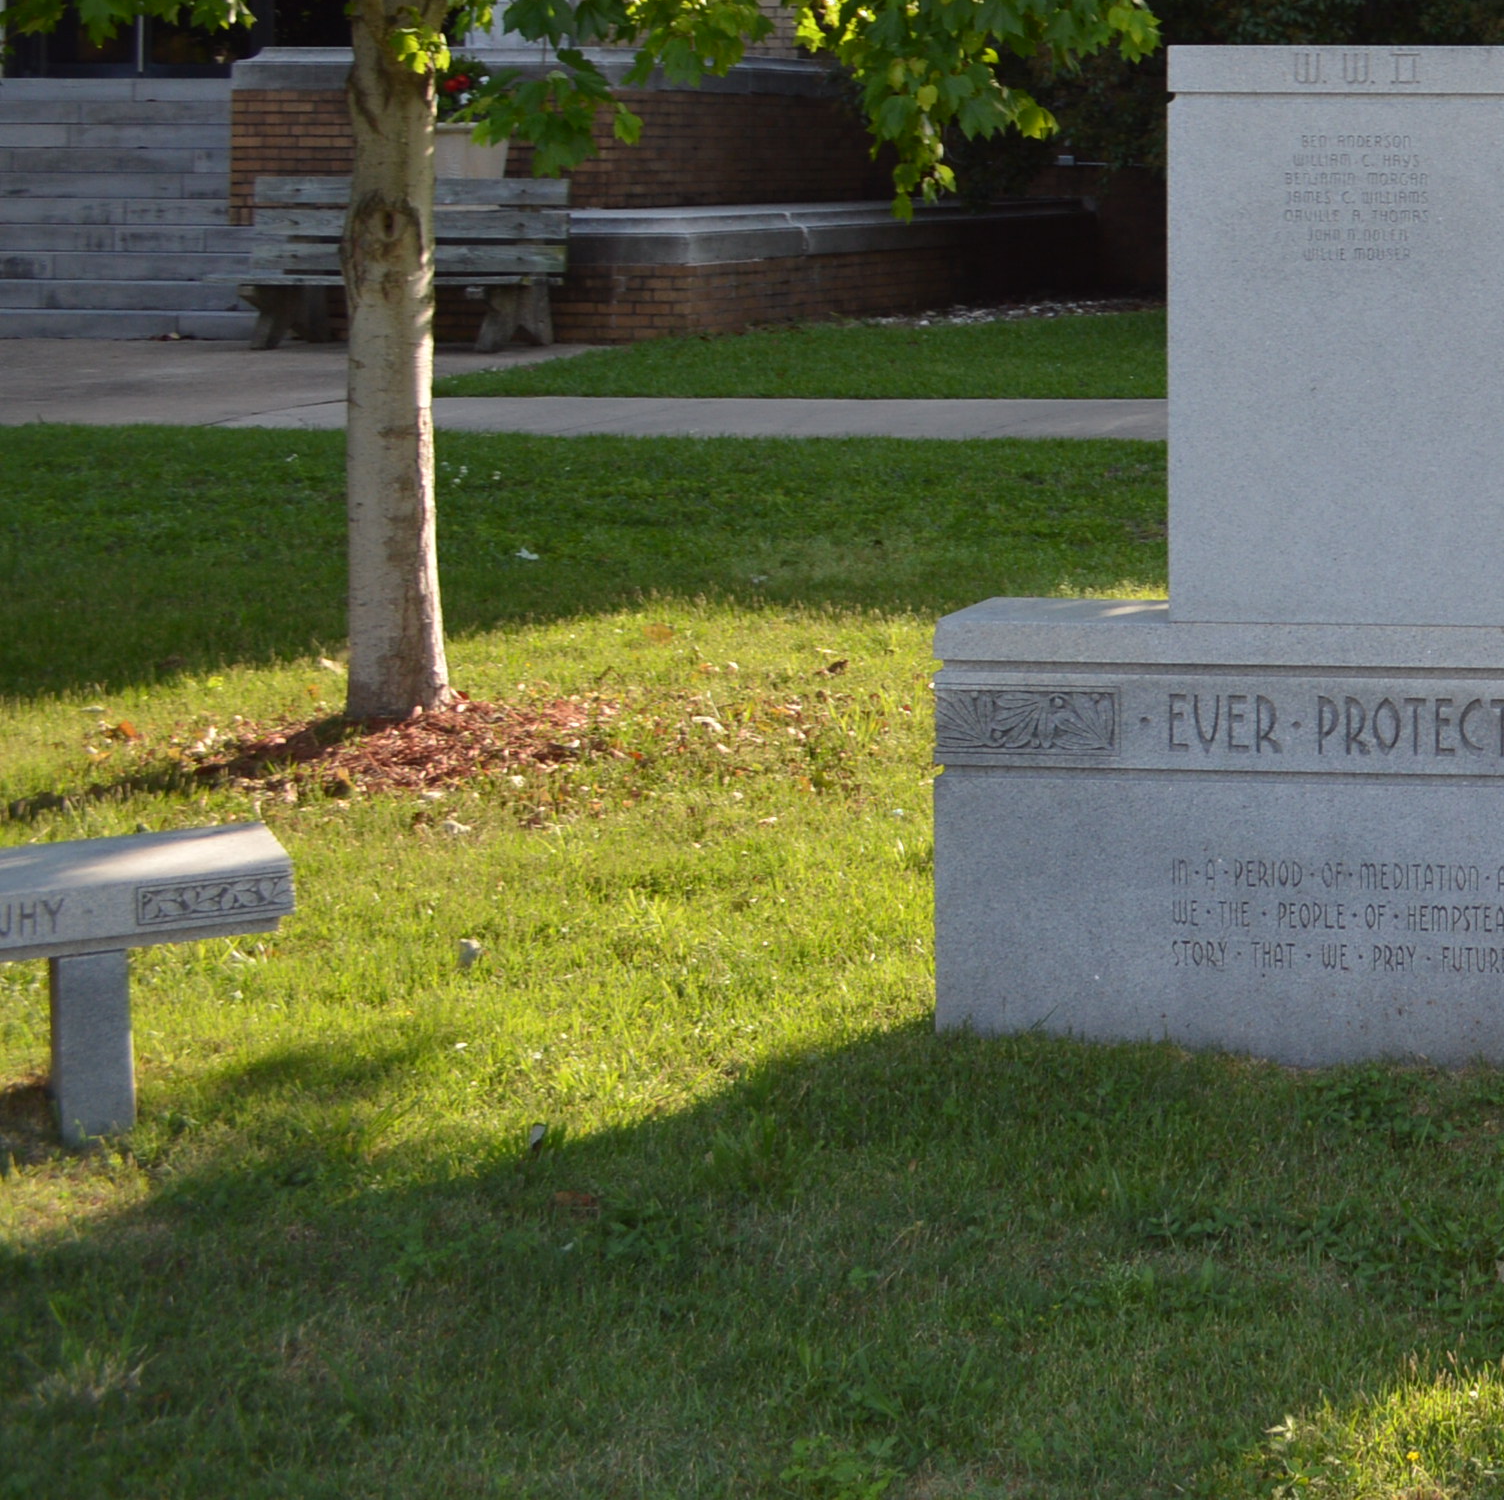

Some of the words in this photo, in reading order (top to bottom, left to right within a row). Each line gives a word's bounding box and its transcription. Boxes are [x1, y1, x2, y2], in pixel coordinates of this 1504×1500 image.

[1294, 53, 1327, 84] W.
[1343, 53, 1376, 84] W.
[1390, 53, 1421, 84] II
[1301, 135, 1326, 148] BEN
[1337, 135, 1412, 149] ANDERSON
[1293, 154, 1349, 167] WILLIAM
[1383, 154, 1420, 168] HAYS
[1168, 693, 1283, 754] EVER
[1171, 859, 1188, 886] IN
[1205, 859, 1216, 886] A
[1233, 859, 1303, 888] PERIOD
[1321, 862, 1344, 887] OF
[1360, 862, 1480, 891] MEDITATION
[1172, 900, 1199, 926] WE
[1218, 901, 1251, 928] THE
[1277, 902, 1346, 930] PEOPLE
[1365, 904, 1386, 930] OF
[1171, 940, 1228, 969] STORY
[1251, 942, 1296, 970] THAT
[1321, 944, 1348, 971] WE
[1373, 944, 1417, 972] PRAY
